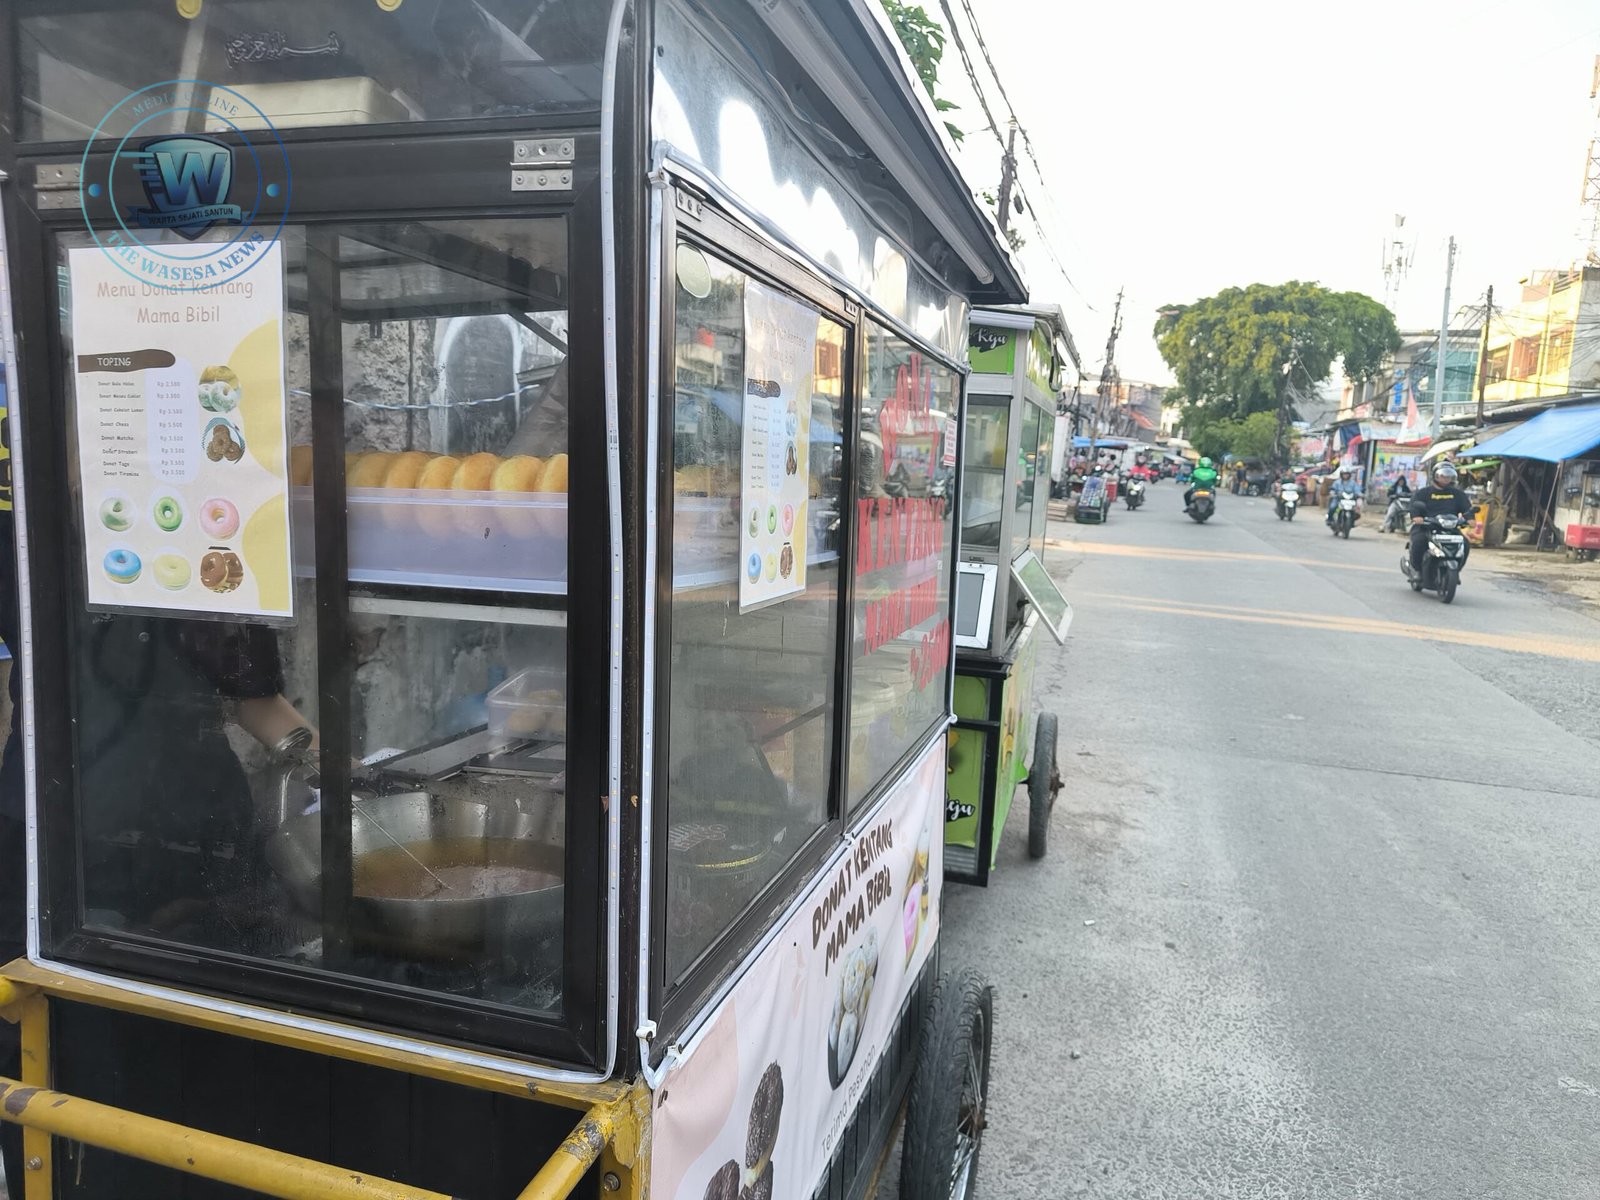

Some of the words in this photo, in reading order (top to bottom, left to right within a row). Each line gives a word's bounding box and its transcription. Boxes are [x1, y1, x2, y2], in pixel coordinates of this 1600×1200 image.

[97, 282, 136, 299] Menu
[141, 281, 185, 298] Donat
[137, 308, 180, 324] Mama
[186, 306, 221, 323] Bibil
[97, 357, 131, 367] TOPING
[946, 799, 975, 821] eju
[812, 859, 851, 950] DONAT
[853, 818, 893, 880] KENTANG
[825, 895, 865, 977] MAMA
[822, 1099, 848, 1158] Terima
[848, 1044, 877, 1107] Pesanan
